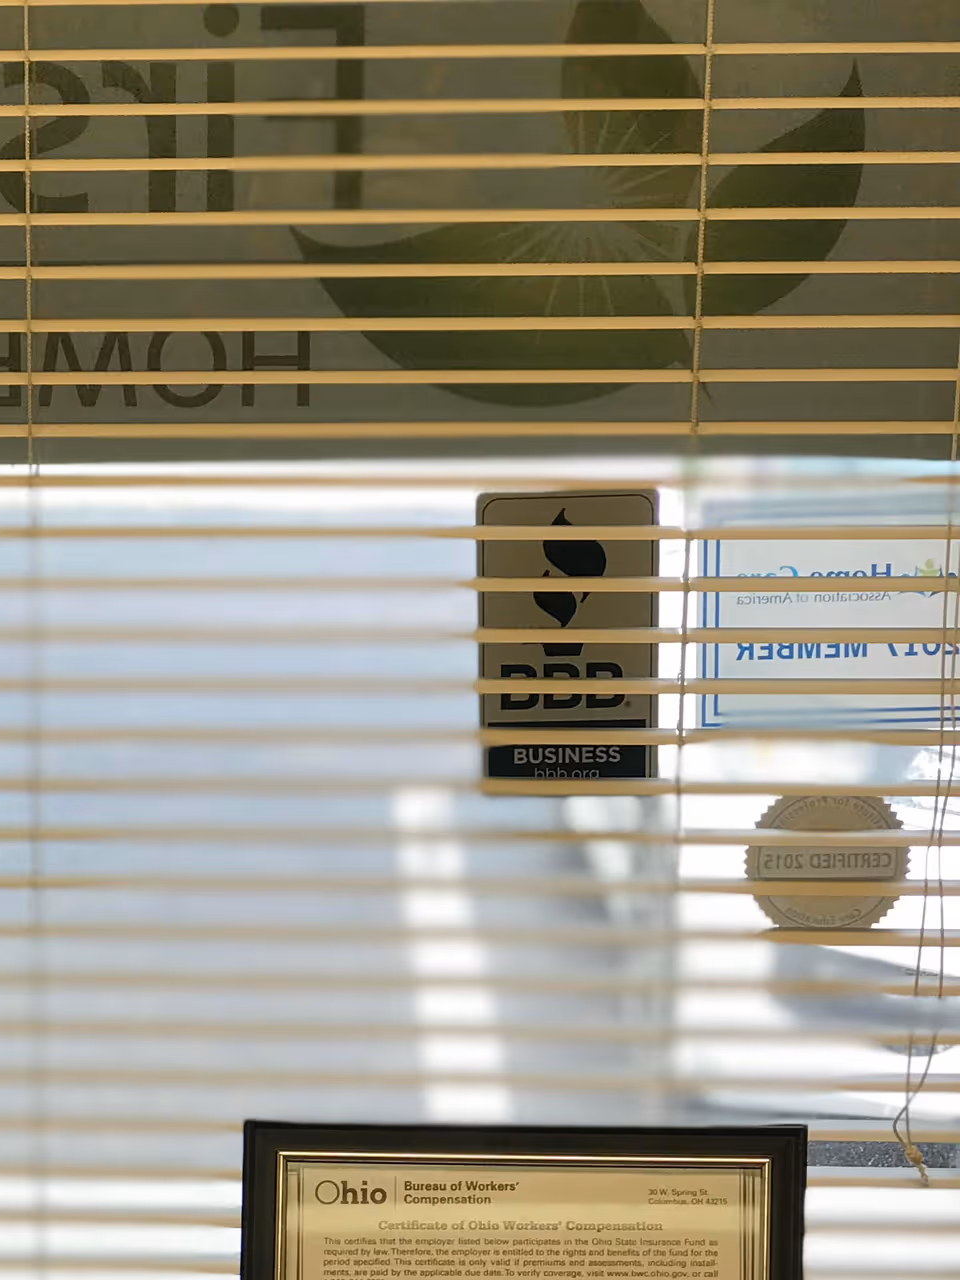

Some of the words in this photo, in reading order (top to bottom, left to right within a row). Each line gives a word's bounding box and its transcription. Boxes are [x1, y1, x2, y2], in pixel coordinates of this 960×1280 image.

[499, 661, 626, 711] BBB
[513, 746, 621, 765] BUSINESS
[533, 767, 600, 780] bbborg
[404, 1180, 446, 1191] Bureau
[450, 1181, 462, 1191] of
[465, 1181, 519, 1191] Workers'
[314, 1179, 388, 1206] Ohio
[403, 1194, 492, 1206] Compensation
[378, 1220, 448, 1232] Certificate
[450, 1220, 464, 1232] of
[468, 1220, 500, 1232] Ohio
[503, 1221, 563, 1232] Workers'
[566, 1221, 664, 1233] Compensation
